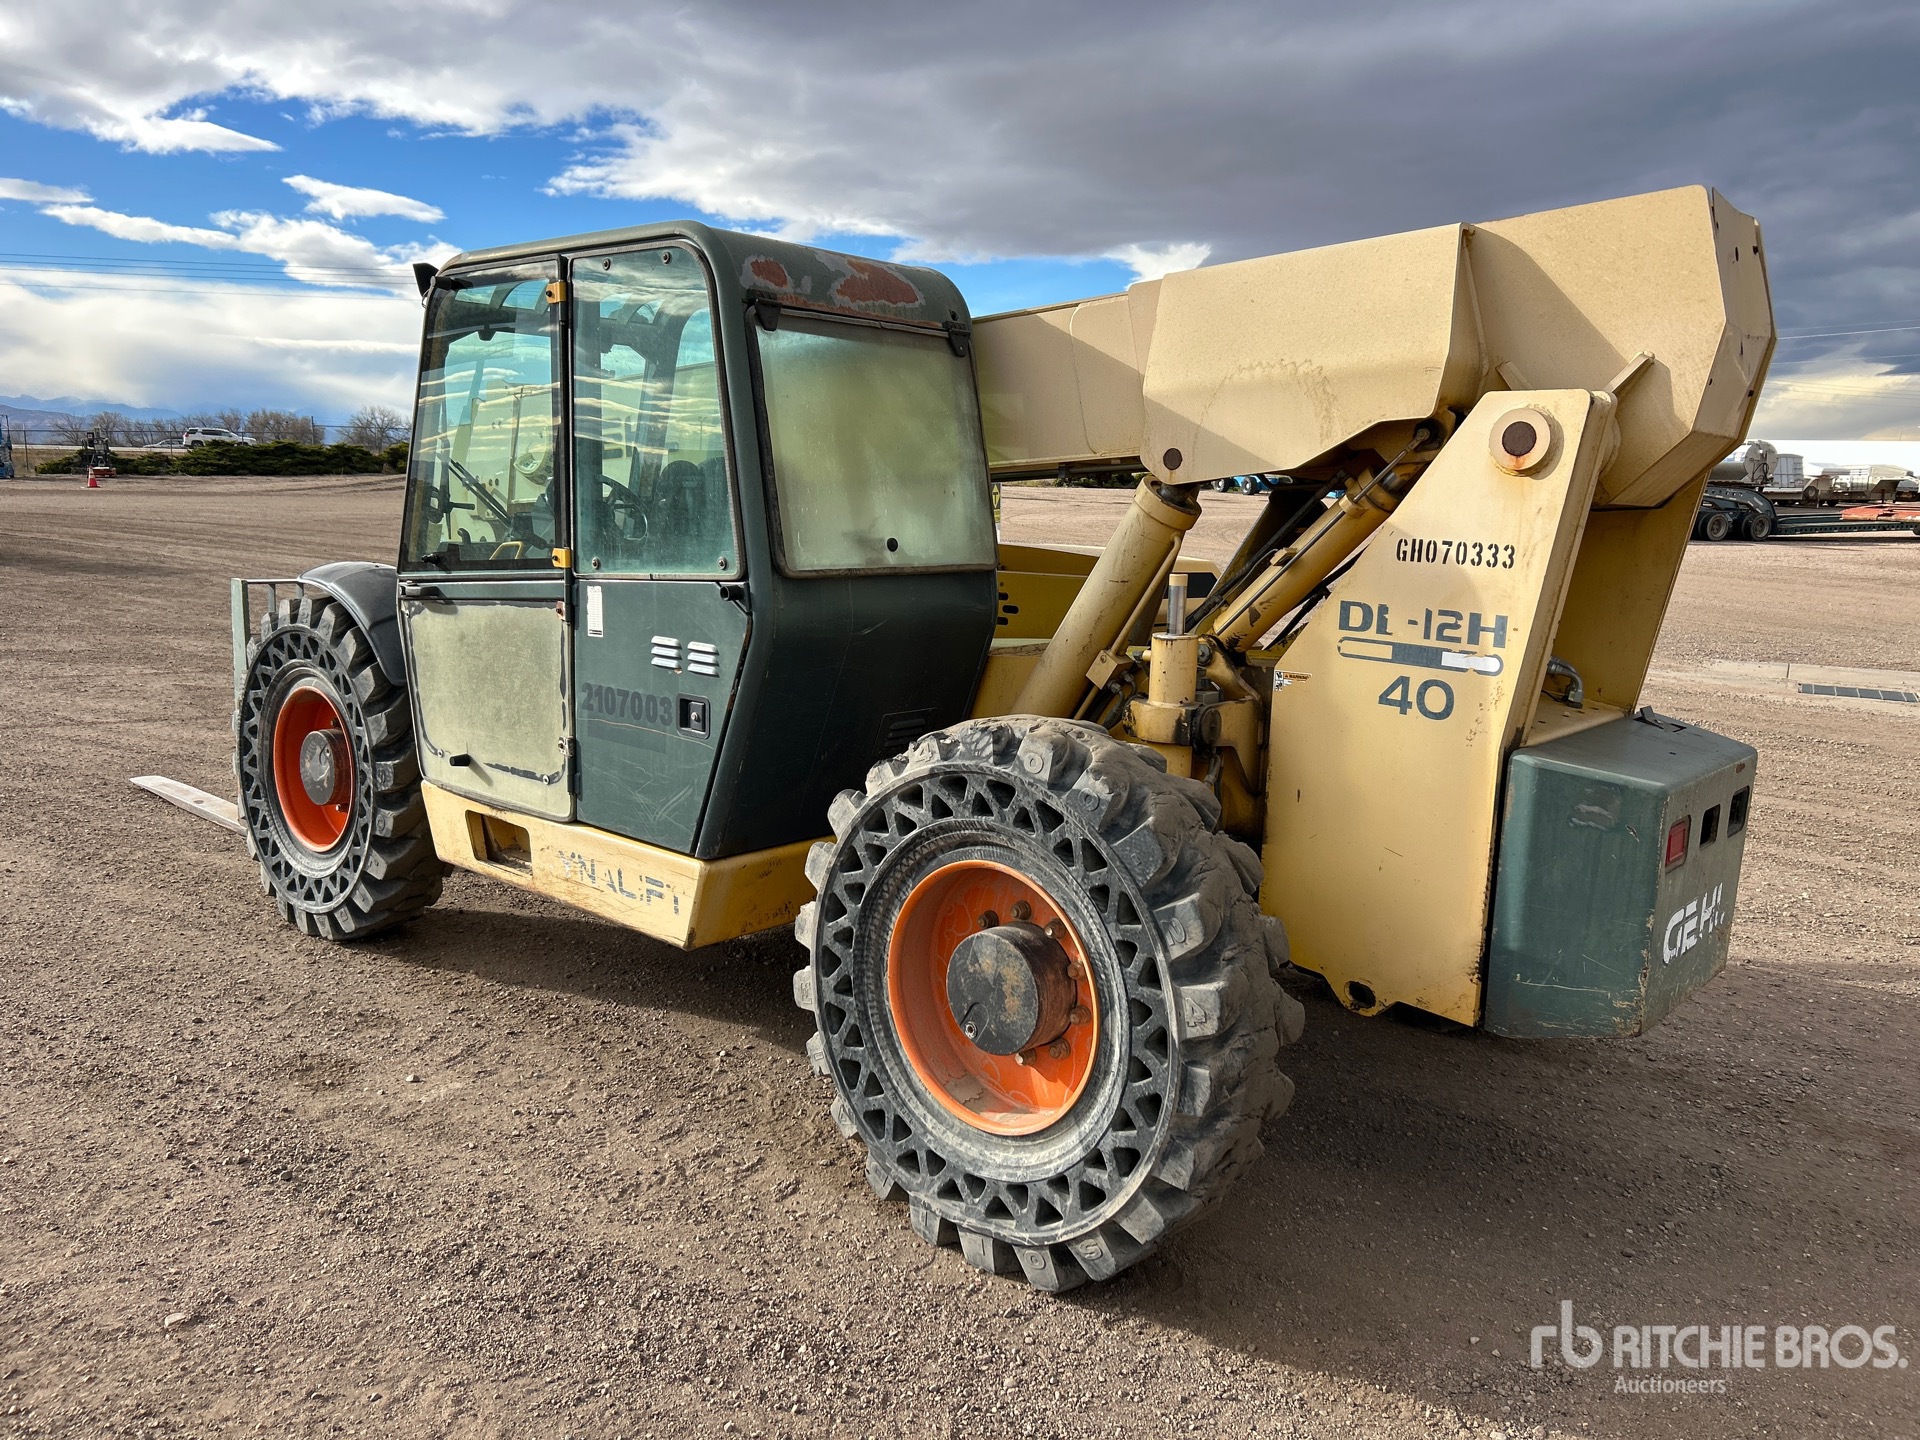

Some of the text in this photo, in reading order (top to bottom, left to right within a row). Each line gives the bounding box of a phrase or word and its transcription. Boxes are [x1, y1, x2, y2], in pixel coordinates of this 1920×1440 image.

[1396, 538, 1516, 570] GH070333
[581, 682, 673, 727] 2107003
[1377, 675, 1455, 721] 40
